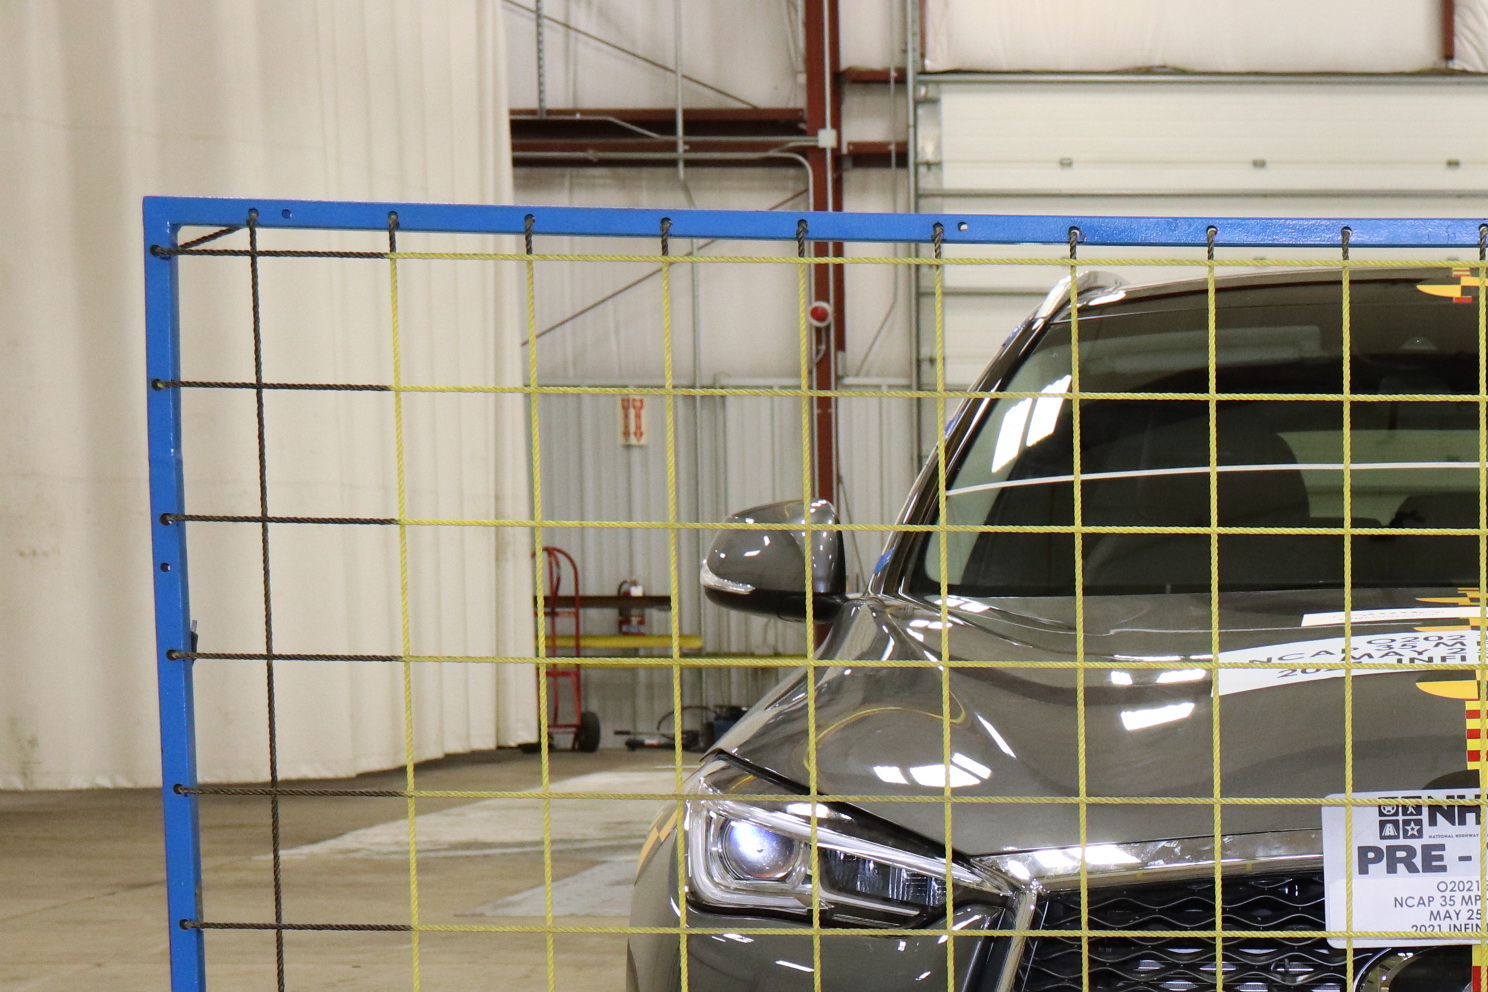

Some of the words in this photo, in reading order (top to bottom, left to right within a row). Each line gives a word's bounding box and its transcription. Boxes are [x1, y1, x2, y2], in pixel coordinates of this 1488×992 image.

[1249, 647, 1360, 664] NCAP
[1374, 643, 1418, 651] 35
[1338, 648, 1432, 662] MAY
[1357, 844, 1448, 875] PRE
[1394, 895, 1435, 908] NCAP
[1440, 894, 1456, 907] 35
[1429, 909, 1462, 921] MAY
[1411, 924, 1442, 933] 2021
